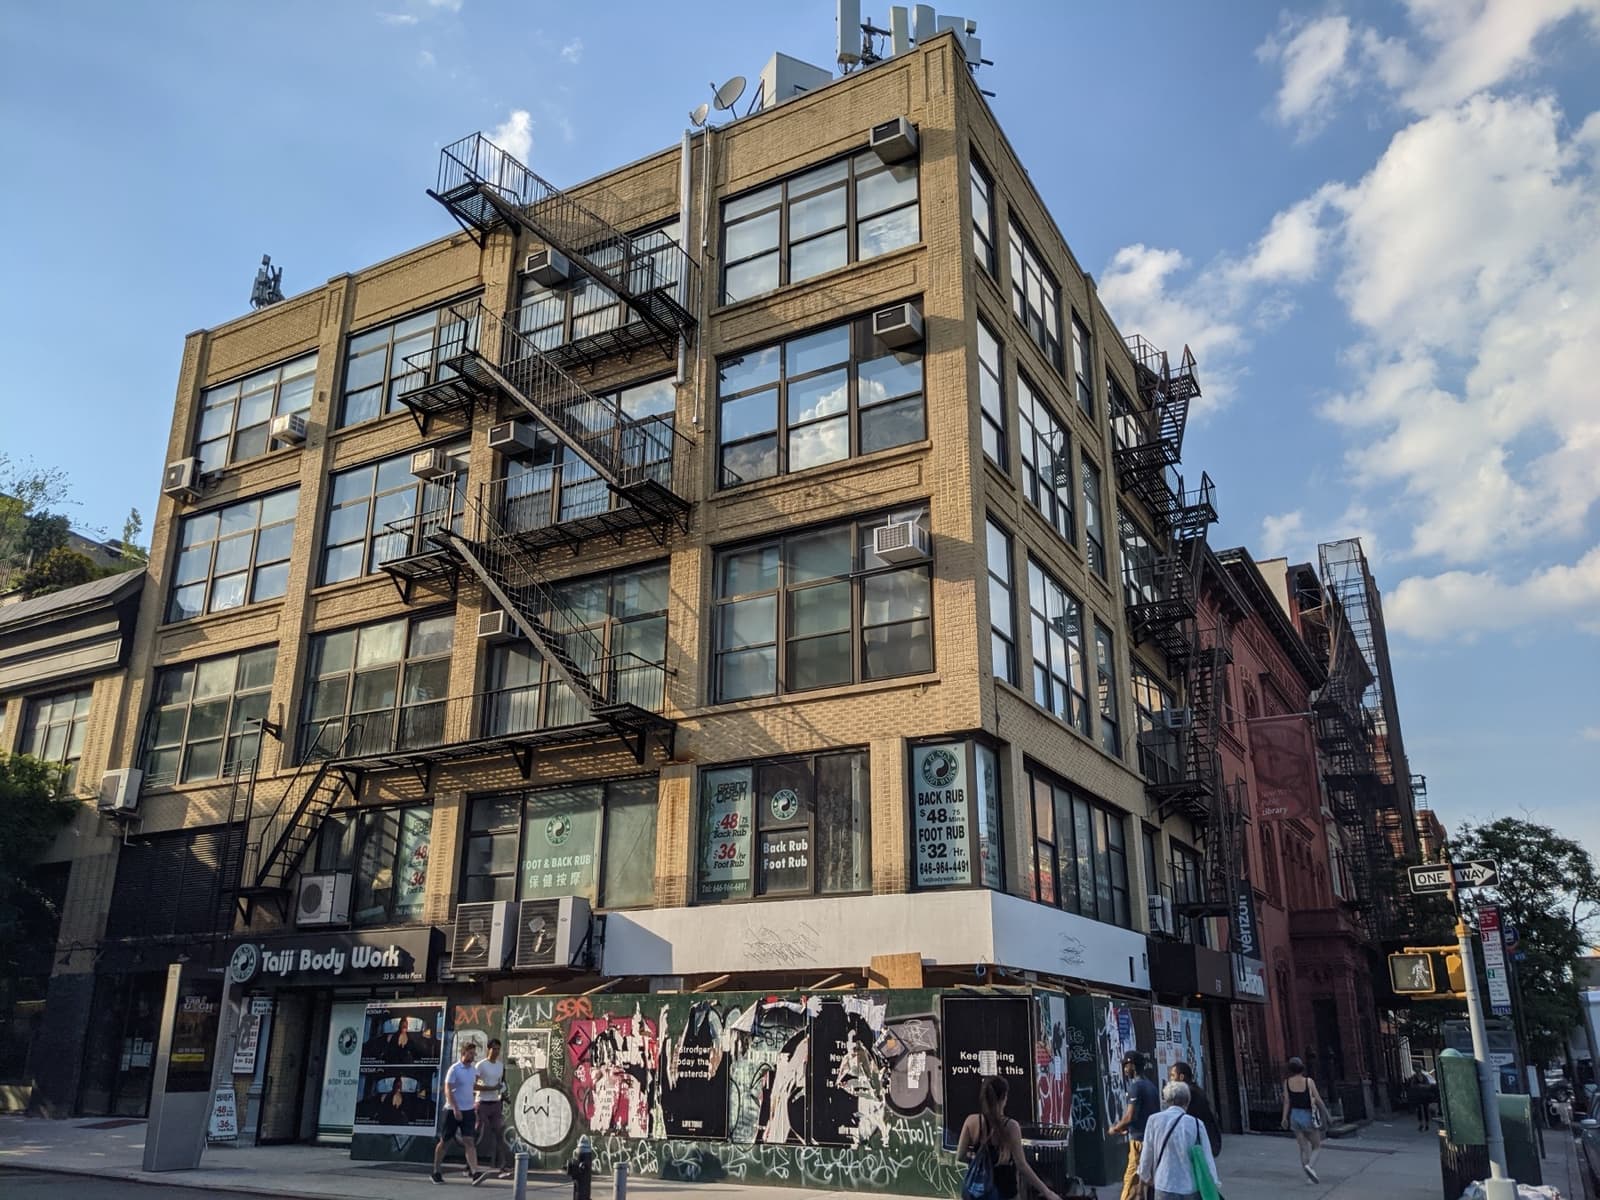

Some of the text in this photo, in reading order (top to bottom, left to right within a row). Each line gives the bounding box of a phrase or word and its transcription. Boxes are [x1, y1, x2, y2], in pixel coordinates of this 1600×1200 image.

[919, 789, 964, 806] BACK RUB
[1262, 807, 1288, 816] Library
[732, 829, 747, 838] Rub
[919, 825, 965, 842] FOOT RUB
[763, 838, 808, 854] Back Rub
[543, 858, 550, 869] &
[551, 855, 573, 868] BACK
[574, 854, 591, 866] RUB
[730, 859, 744, 868] Rub
[763, 855, 808, 870] Foot Rub
[919, 860, 969, 875] 646-964-4491
[1417, 869, 1487, 885] ONE WAY
[1238, 895, 1252, 954] verizon
[261, 949, 295, 976] Taiji
[300, 948, 345, 974] Body
[351, 945, 400, 969] Work
[677, 1057, 710, 1068] oday tha
[960, 1051, 980, 1062] Kee
[1005, 1066, 1025, 1076] this
